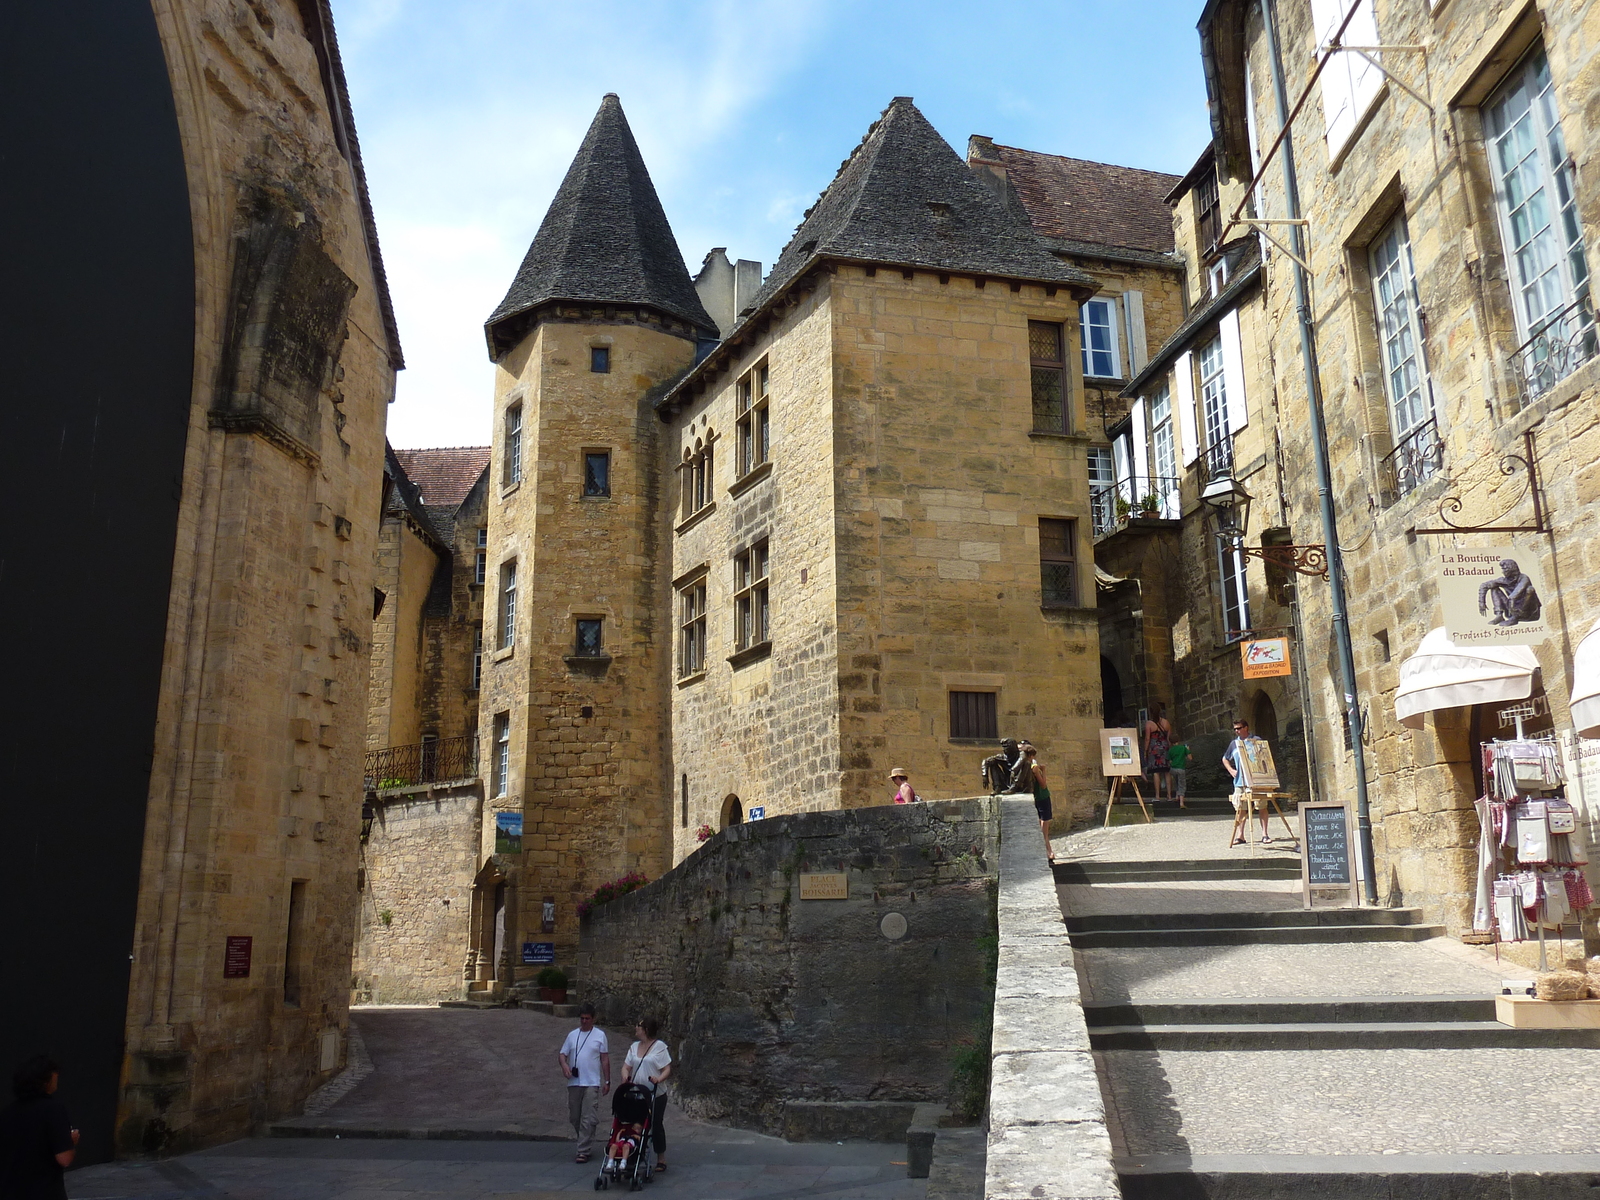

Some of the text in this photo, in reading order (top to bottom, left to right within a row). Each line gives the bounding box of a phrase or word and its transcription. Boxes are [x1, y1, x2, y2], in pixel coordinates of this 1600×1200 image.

[1441, 554, 1501, 564] La Boutique
[1443, 567, 1494, 576] du Badaud
[1452, 626, 1544, 642] Produits Régionaux
[1562, 736, 1573, 748] La
[1568, 750, 1577, 761] du
[1308, 824, 1312, 832] 3
[1313, 825, 1328, 834] pour
[1308, 834, 1313, 842] 4
[1313, 834, 1329, 843] pour
[1314, 844, 1329, 852] pour
[802, 889, 845, 897] BOISSARIE
